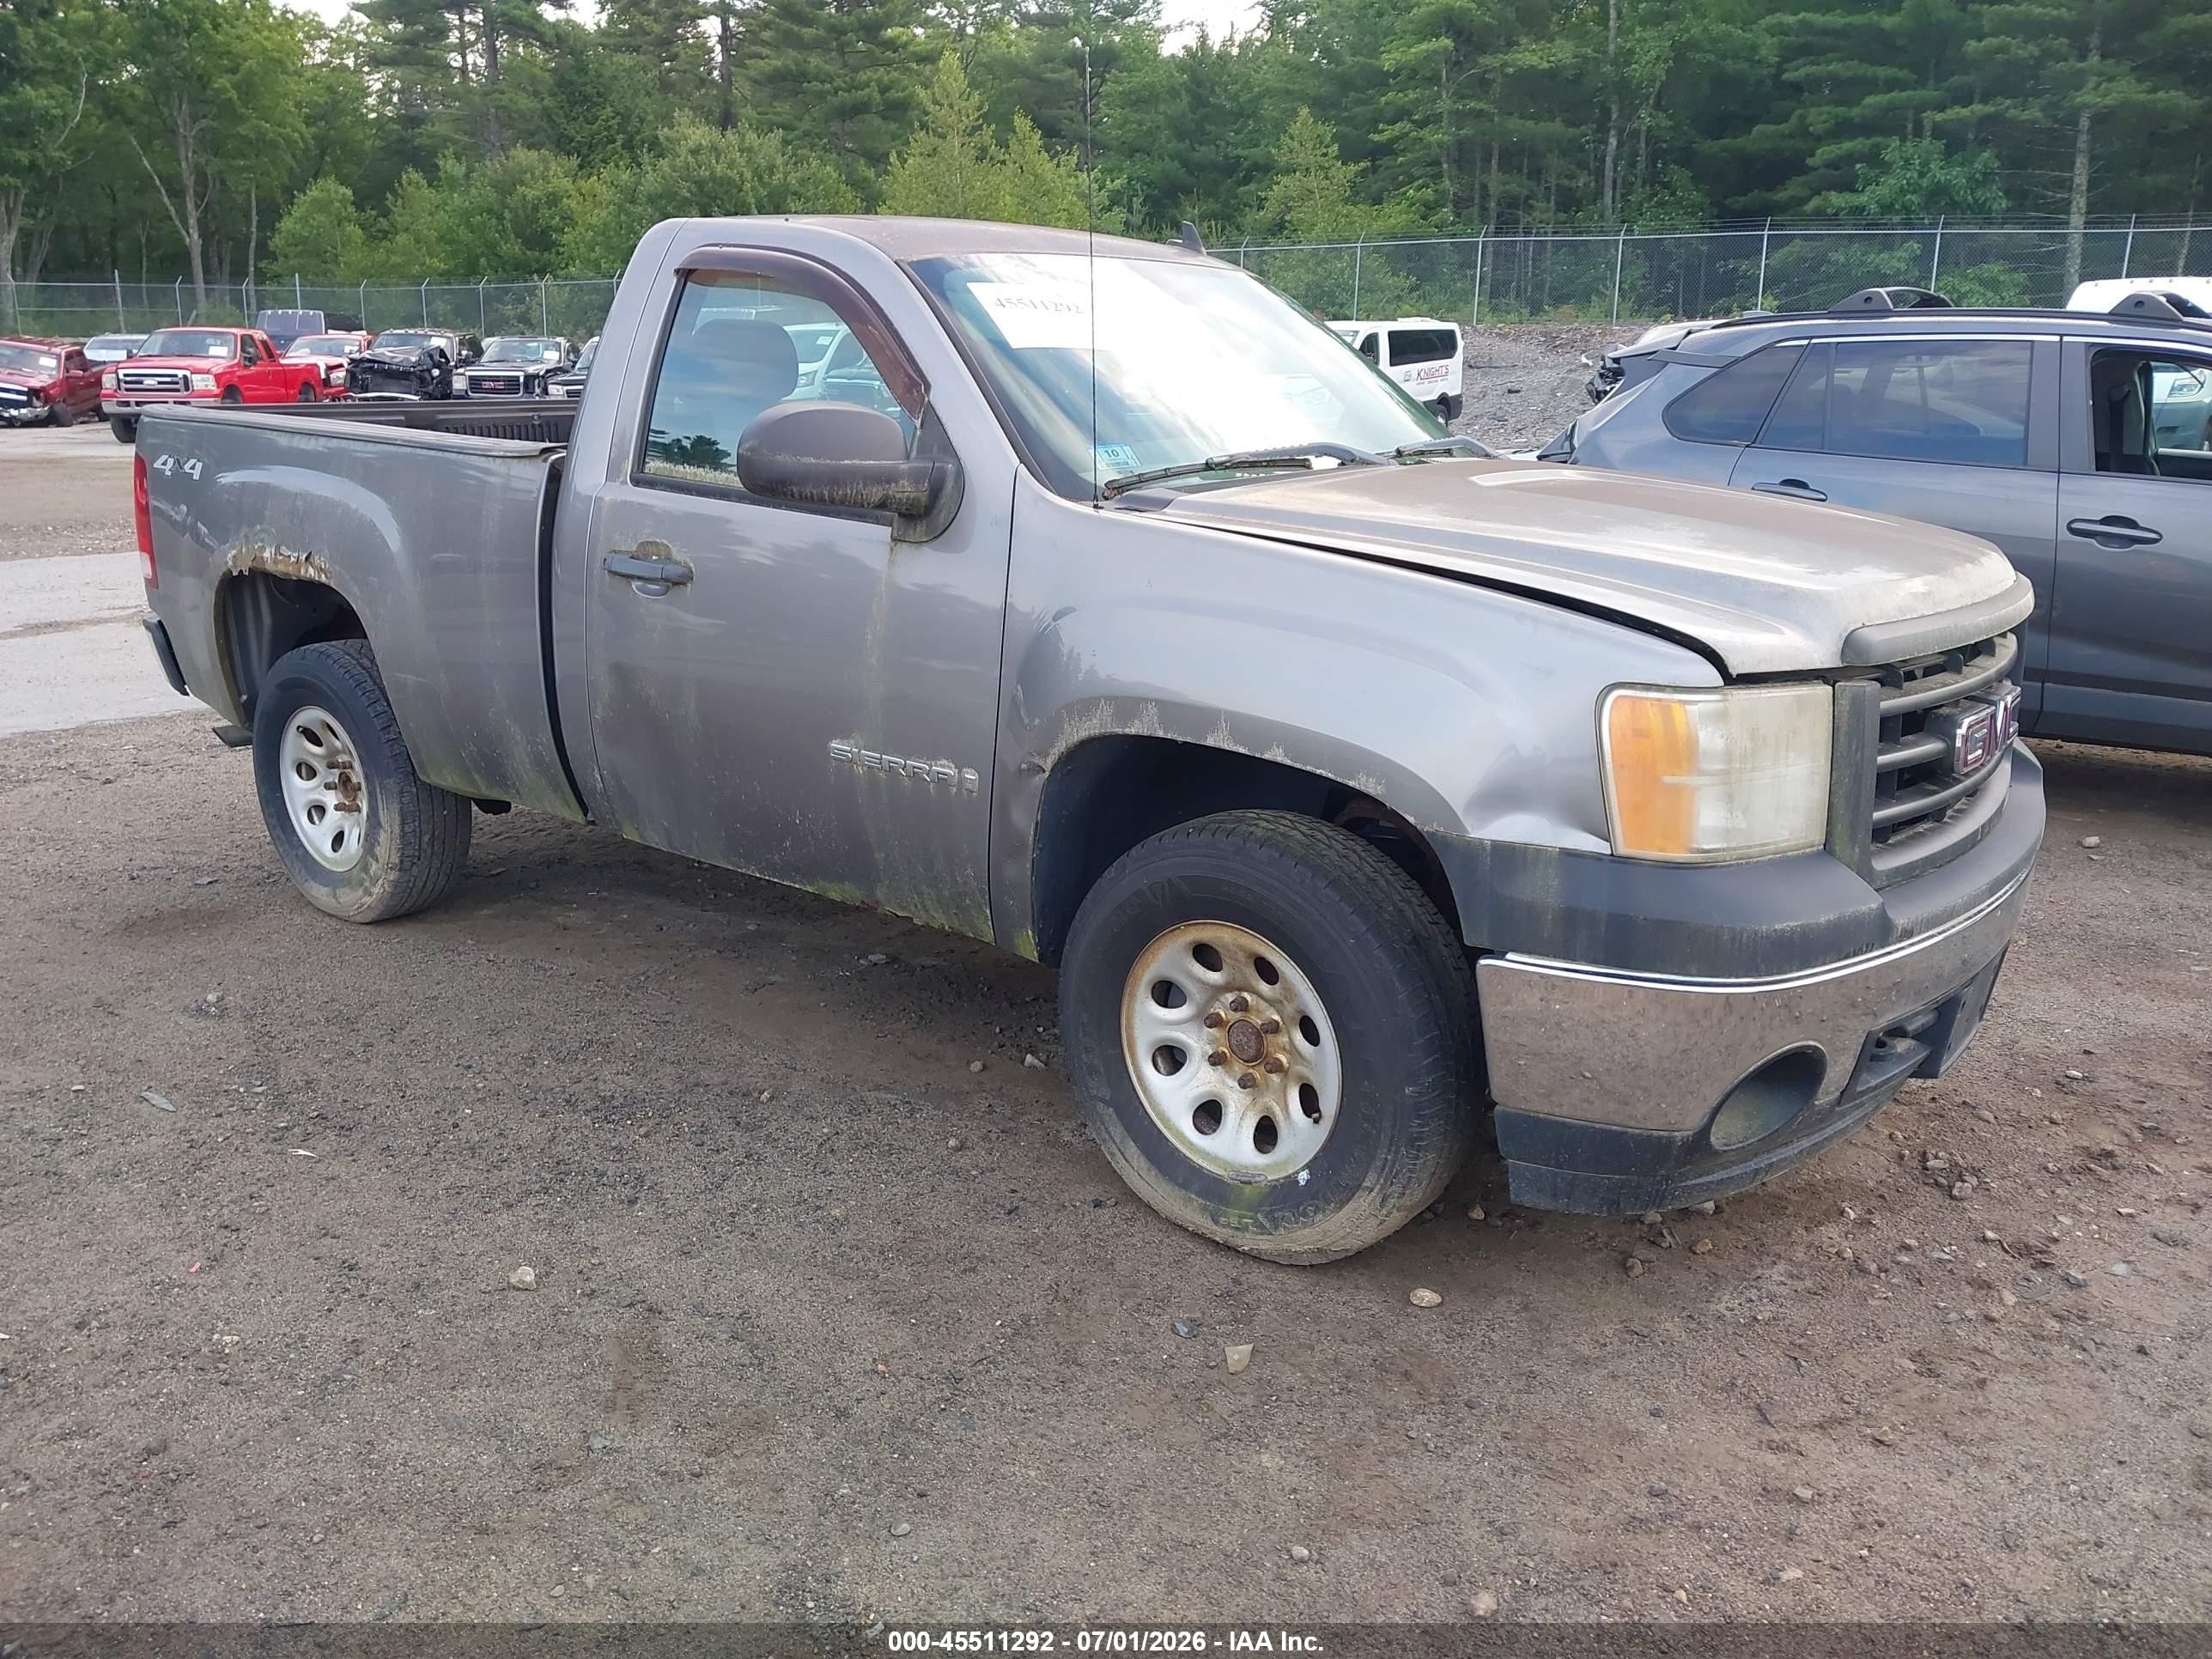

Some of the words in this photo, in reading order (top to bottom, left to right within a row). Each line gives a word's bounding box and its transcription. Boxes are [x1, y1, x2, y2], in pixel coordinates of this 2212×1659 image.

[1104, 449, 1120, 458] 10
[1954, 686, 2022, 775] GMC
[830, 743, 958, 787] SIERRA
